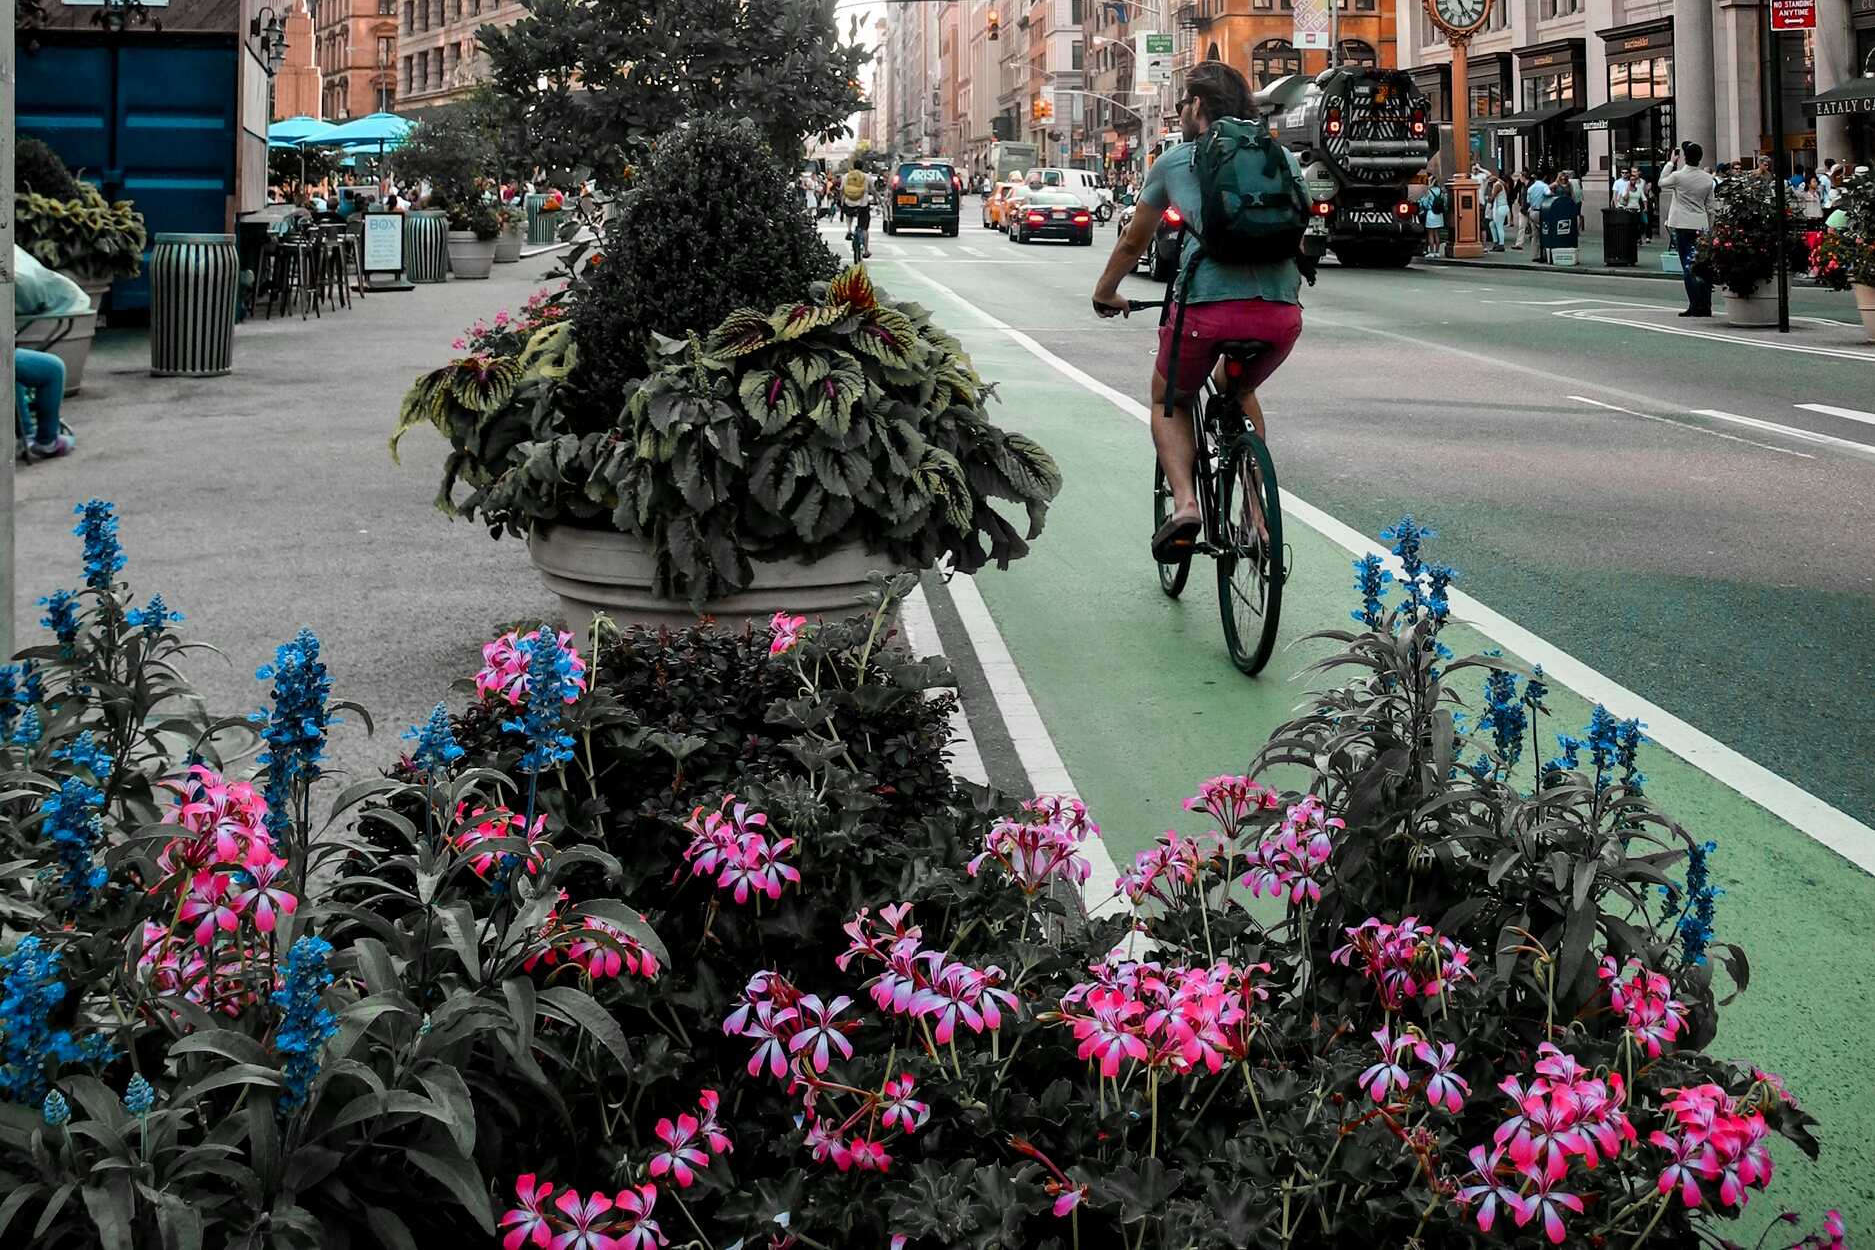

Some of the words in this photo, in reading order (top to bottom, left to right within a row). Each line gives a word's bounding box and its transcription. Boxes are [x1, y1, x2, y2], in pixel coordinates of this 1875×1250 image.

[1773, 1, 1782, 9] NO
[1785, 0, 1814, 8] STANDING
[1779, 9, 1809, 17] ANYTIME
[1816, 100, 1858, 115] EATALY
[908, 169, 946, 182] ARISTA
[370, 218, 397, 230] BOX
